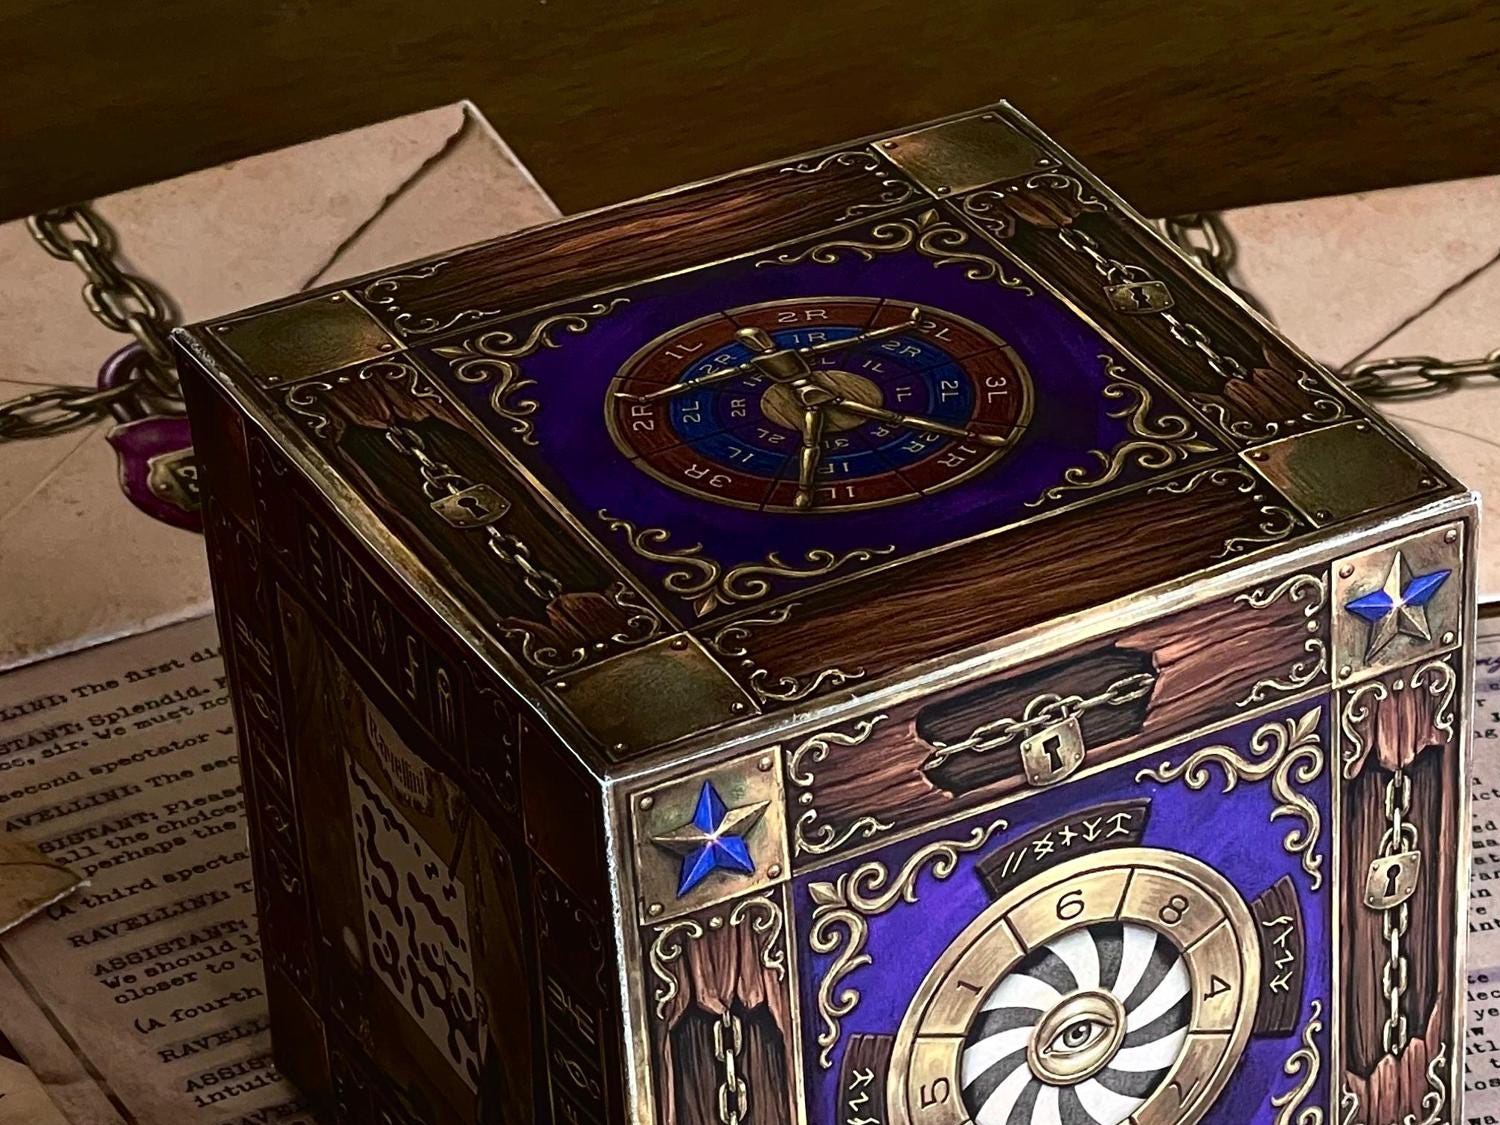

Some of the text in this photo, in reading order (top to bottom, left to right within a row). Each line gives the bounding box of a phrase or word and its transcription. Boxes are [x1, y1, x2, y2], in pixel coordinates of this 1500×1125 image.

[778, 309, 829, 323] 2R
[880, 339, 922, 358] 2R
[940, 379, 959, 403] 2L
[984, 376, 1009, 404] 3L
[681, 401, 701, 423] 2L
[683, 463, 733, 488] 3R
[124, 657, 186, 683] first
[86, 685, 212, 728] Splendid.
[88, 733, 211, 778] spectator
[82, 836, 188, 878] perhaps
[66, 891, 232, 948] RAVELLINI:
[1055, 889, 1086, 920] 6
[1158, 894, 1191, 925] 8
[92, 918, 250, 978] ASSISTANT:
[143, 938, 239, 978] should
[112, 970, 199, 1005] closer
[1202, 974, 1232, 1003] 4
[172, 985, 264, 1025] fourth
[919, 1086, 950, 1109] 5
